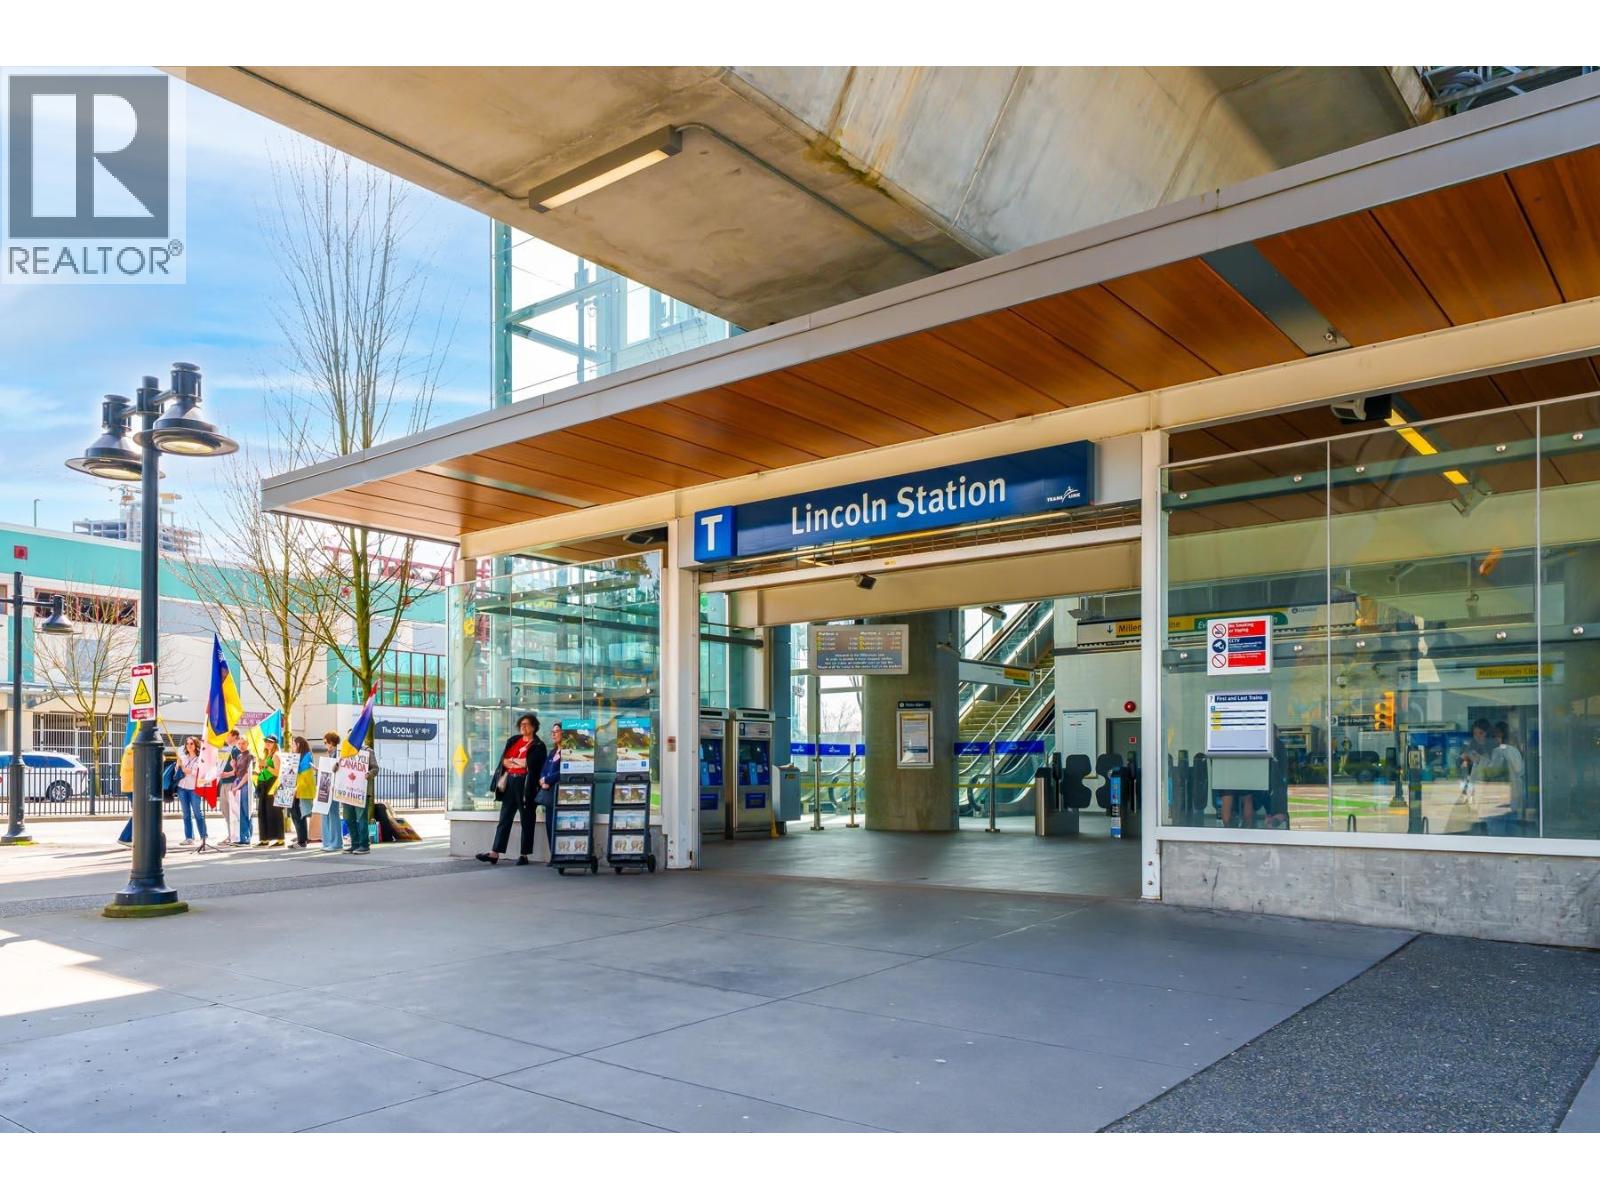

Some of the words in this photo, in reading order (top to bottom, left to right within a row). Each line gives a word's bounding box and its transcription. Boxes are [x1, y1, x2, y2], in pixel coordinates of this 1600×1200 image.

[700, 514, 723, 552] T
[791, 494, 887, 536] Lincoln
[896, 476, 1006, 520] Station
[1118, 624, 1142, 633] Millen
[339, 758, 367, 772] CANADA
